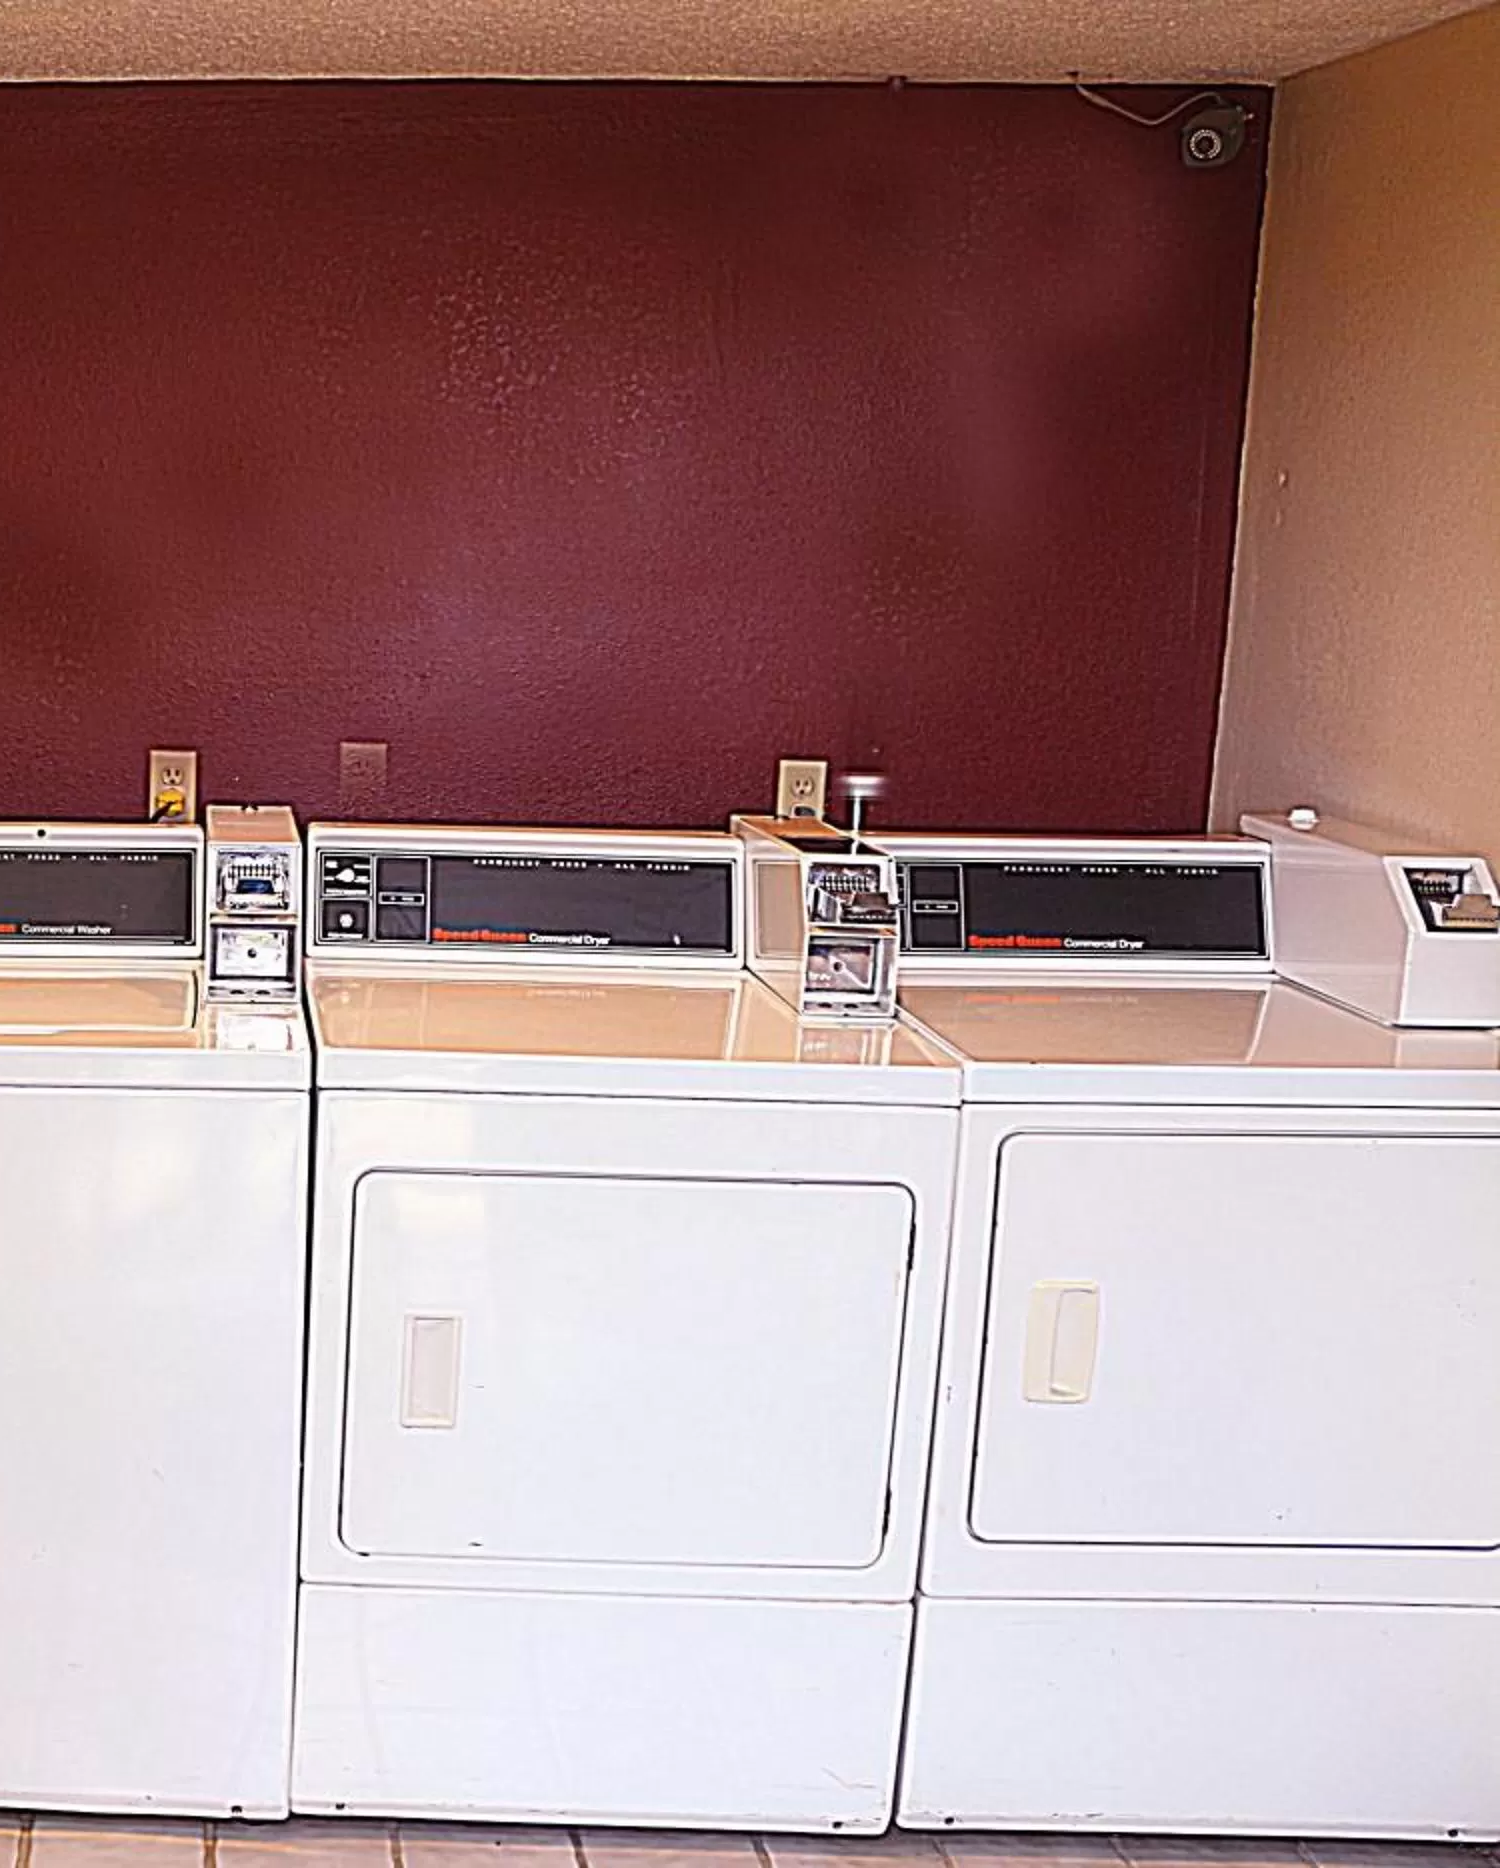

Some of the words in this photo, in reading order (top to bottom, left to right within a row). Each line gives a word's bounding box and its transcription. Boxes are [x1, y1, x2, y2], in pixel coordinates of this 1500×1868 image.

[21, 923, 75, 934] Commercial
[77, 925, 112, 935] Washer
[528, 932, 583, 944] Commercial
[584, 934, 612, 946] Dryer
[1063, 937, 1118, 949] Commercial
[1119, 938, 1145, 949] Dryer
